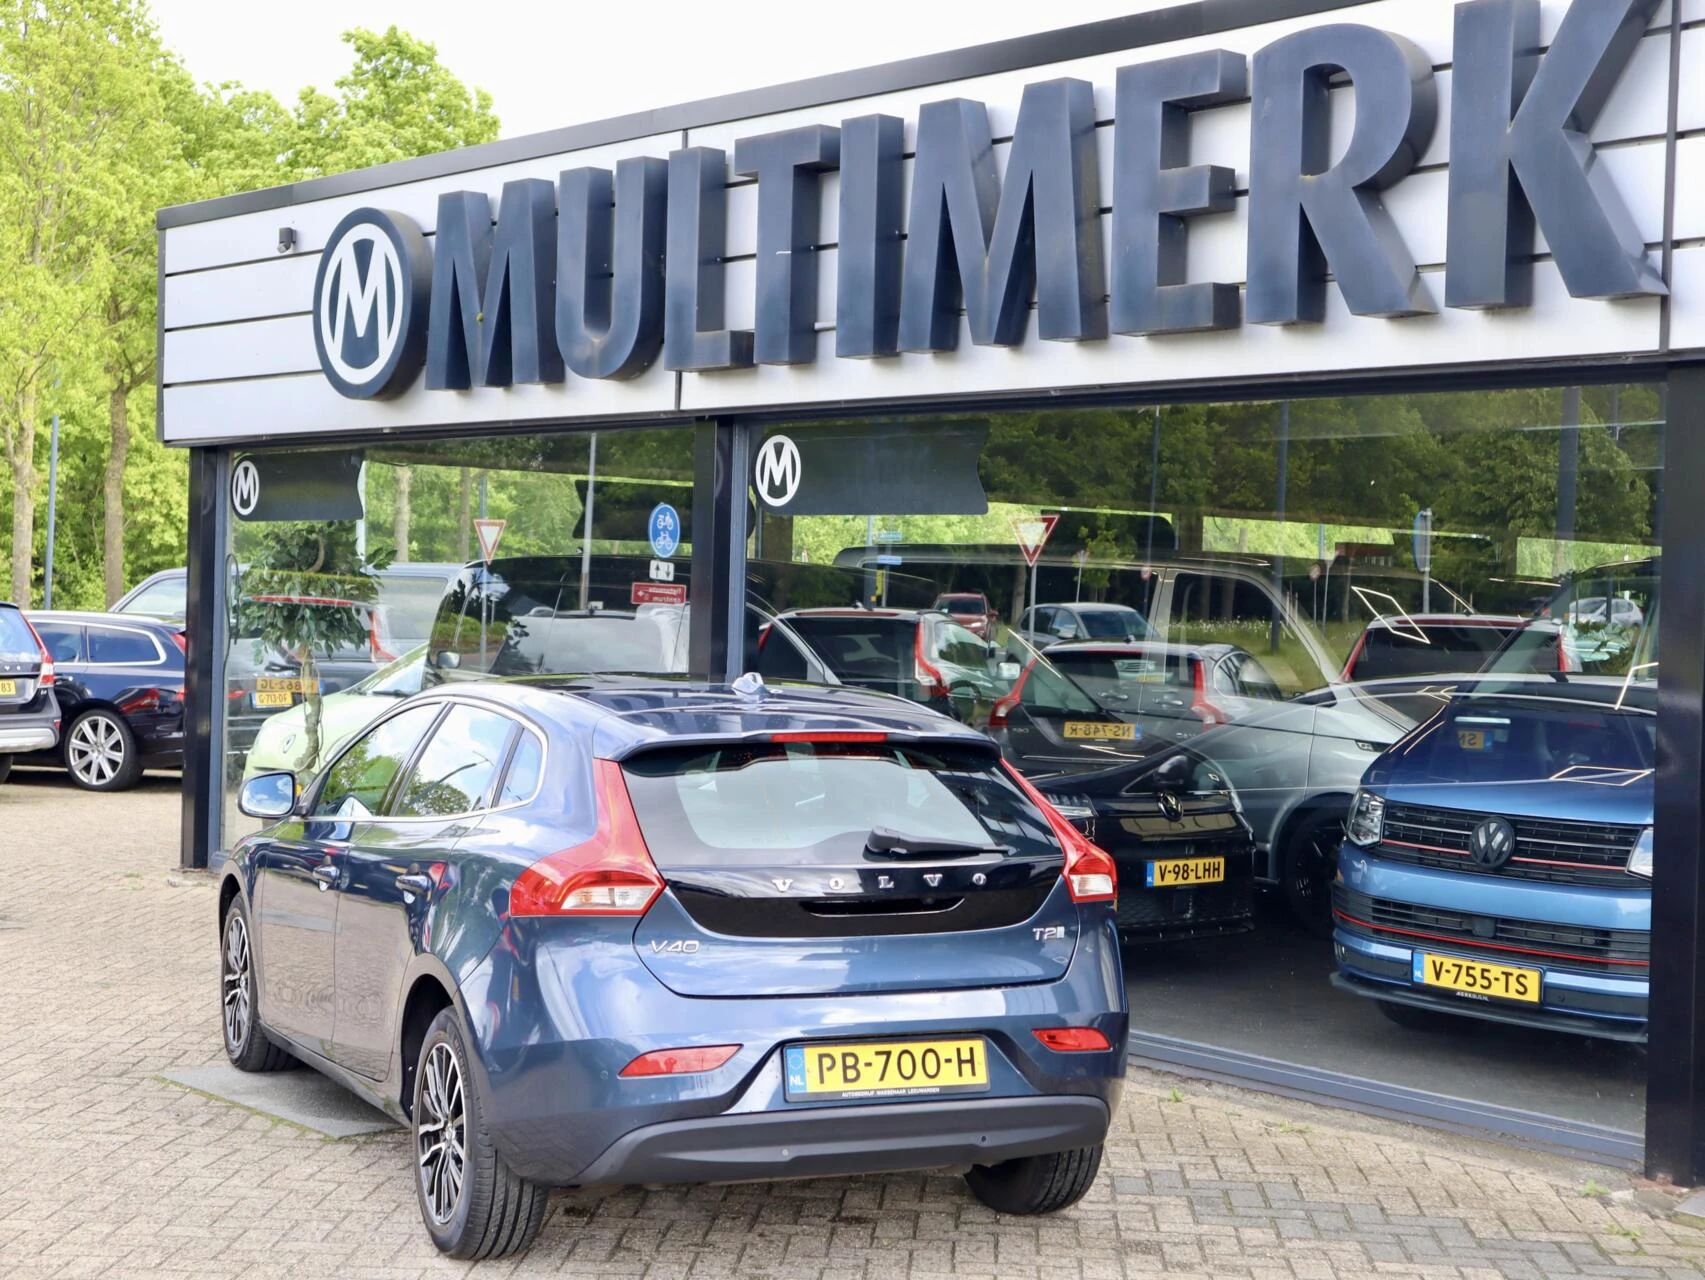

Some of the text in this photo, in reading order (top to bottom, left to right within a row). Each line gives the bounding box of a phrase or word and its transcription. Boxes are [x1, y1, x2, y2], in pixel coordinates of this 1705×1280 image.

[426, 0, 1668, 393] MULTIMERK
[1159, 861, 1221, 882] V-98-LHH
[772, 872, 986, 892] VOLVO
[1032, 926, 1056, 941] T2
[651, 939, 699, 953] V40
[1415, 970, 1424, 979] NL
[1432, 959, 1529, 996] V-755-TS
[789, 1046, 977, 1086] NL PB-700-H
[841, 1089, 876, 1098] AUTOBEDRIJF
[908, 1086, 940, 1096] LEEUWARDEN
